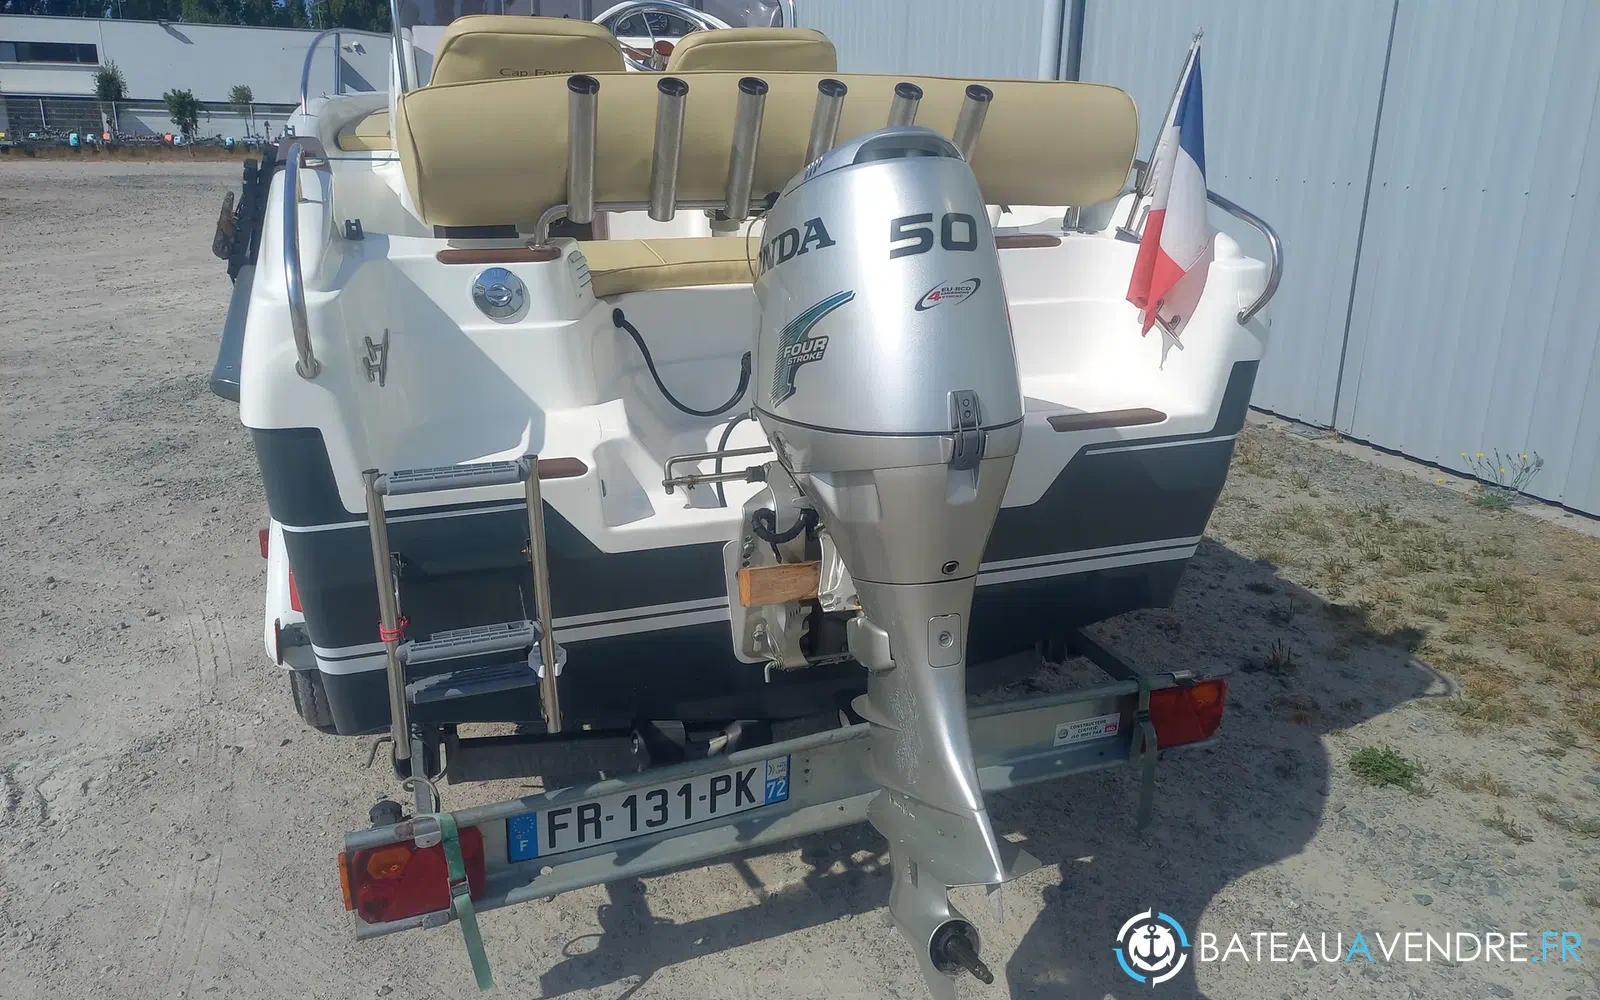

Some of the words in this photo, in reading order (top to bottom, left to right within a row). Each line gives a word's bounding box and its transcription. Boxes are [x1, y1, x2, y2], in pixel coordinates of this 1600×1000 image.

[499, 67, 529, 77] Cap
[889, 212, 978, 260] 50
[760, 216, 836, 276] NDA
[927, 290, 942, 301] 4
[783, 338, 828, 359] FOUR
[787, 350, 823, 365] STROKE
[766, 780, 786, 799] 72
[547, 766, 758, 849] FR-131-PK
[519, 838, 529, 851] F
